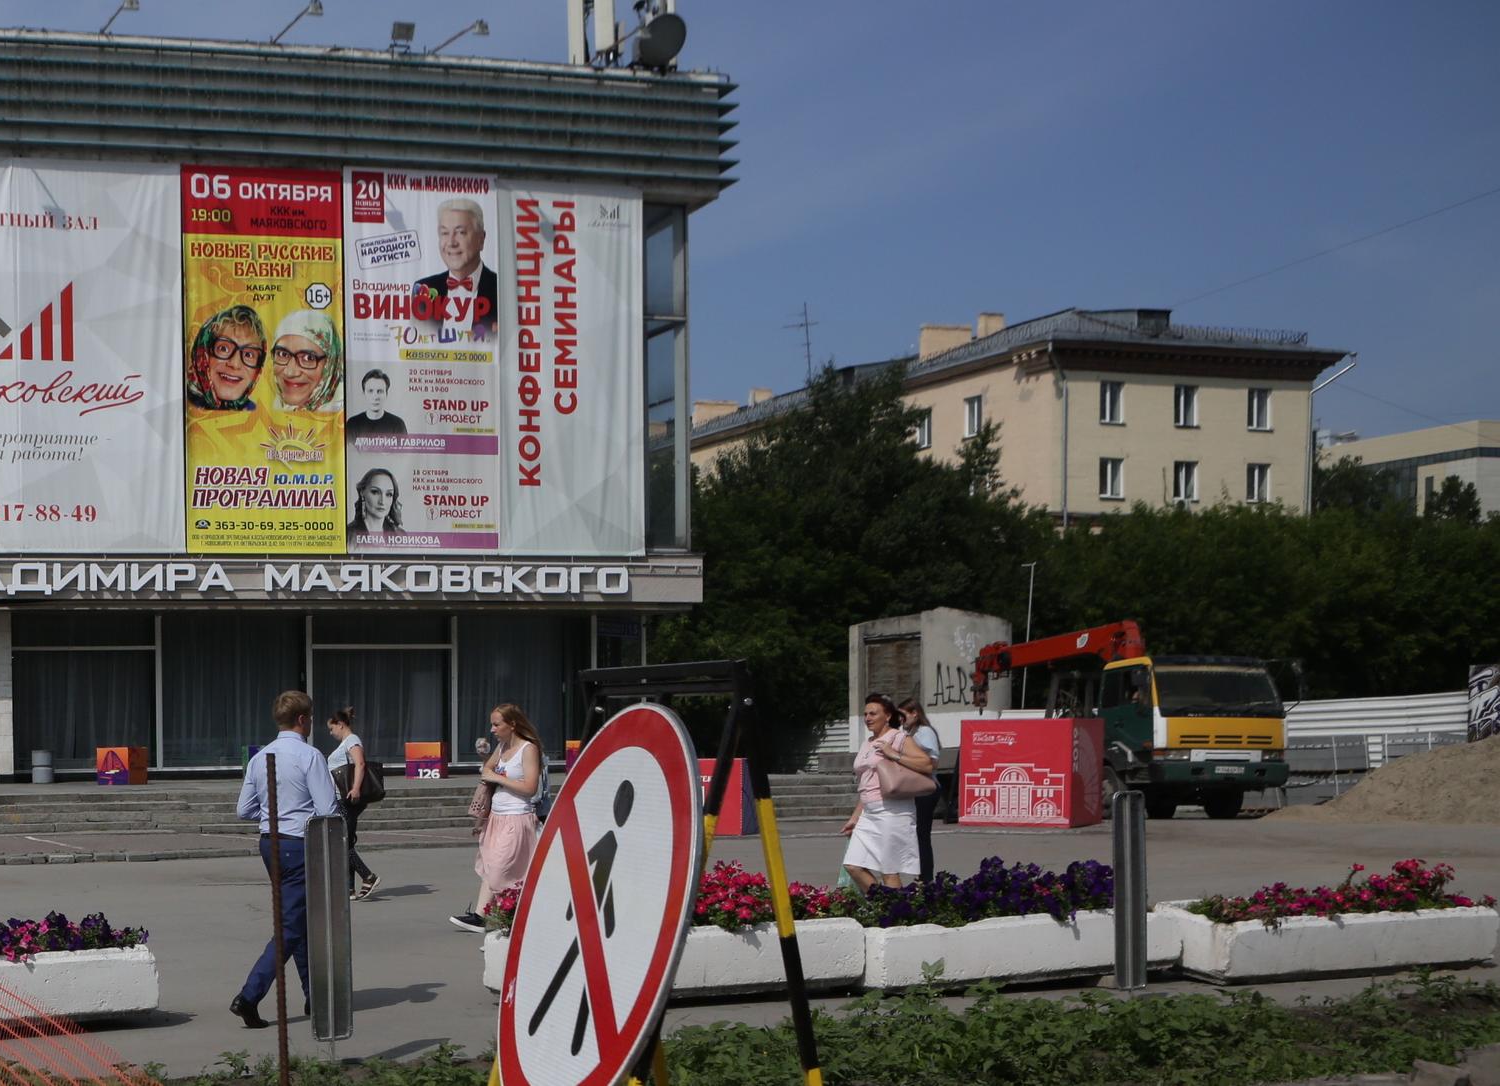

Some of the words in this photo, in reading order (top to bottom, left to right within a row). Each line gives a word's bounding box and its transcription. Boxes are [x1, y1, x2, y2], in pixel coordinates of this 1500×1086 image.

[190, 173, 231, 199] 06
[238, 182, 332, 202] ОКТЯБРЯ
[387, 173, 407, 191] ККК
[356, 179, 380, 200] 20
[191, 208, 231, 222] 19:00
[270, 206, 290, 216] ККК
[62, 213, 99, 231] ЗАЛ
[250, 218, 327, 230] МАЯКОВСКОГО
[360, 236, 398, 248] ЮБИЛЕЙНЫЙ
[361, 240, 416, 256] НАРОДНОГО
[190, 242, 251, 259] НОВЫЕ
[257, 243, 334, 261] РУССКИЕ
[370, 251, 410, 264] АРТИСТА
[233, 261, 293, 278] БАБКИ
[246, 284, 283, 292] КАБАРЕ
[352, 279, 411, 293] Владимир
[252, 294, 276, 302] ДУЭТ
[308, 288, 330, 304] 16+
[353, 293, 491, 322] ВИНОКУР
[553, 201, 578, 415] СЕМИНАРЫ
[516, 199, 545, 487] КОНФЕРЕНЦИИ
[452, 353, 467, 361] 325
[469, 353, 487, 362] 0000
[423, 399, 467, 411] STAND
[470, 400, 489, 412] UP
[439, 415, 481, 425] PROJECT
[354, 436, 398, 446] ДМИТРИЙ
[400, 438, 446, 447] ГАВРИЛОВ
[11, 446, 84, 463] работа!
[194, 466, 270, 487] НОВАЯ
[192, 489, 337, 510] ПРОГРАММА
[423, 495, 467, 506] STAND
[470, 495, 489, 507] UP
[439, 509, 482, 519] PROJECT
[279, 521, 334, 531] 325-0000
[356, 535, 385, 544] ЕЛЕНА
[388, 536, 440, 545] НОВИКОВА
[263, 564, 631, 594] МАЯКОВСКОГО
[418, 768, 440, 779] 126
